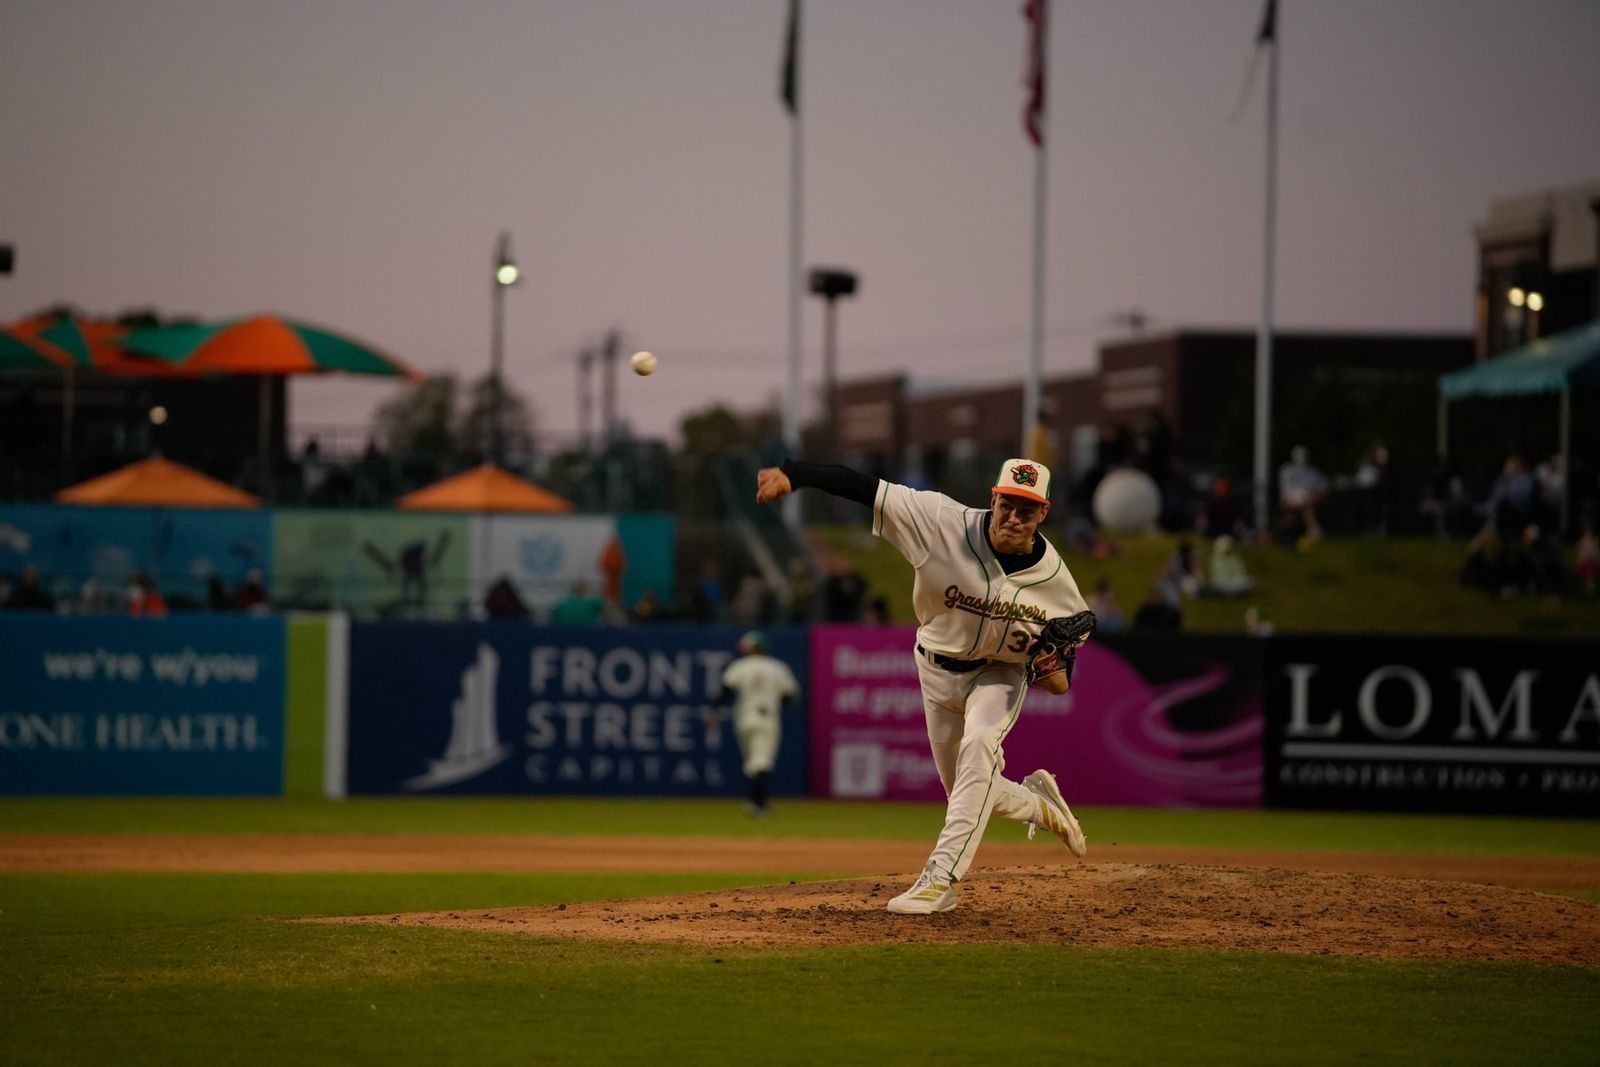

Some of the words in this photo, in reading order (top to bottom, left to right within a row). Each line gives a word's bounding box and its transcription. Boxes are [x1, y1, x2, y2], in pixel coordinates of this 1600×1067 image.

[944, 584, 1046, 624] Grasshoppers
[44, 650, 143, 681] we're
[151, 648, 258, 686] w/you
[529, 646, 732, 698] FRONT
[833, 646, 917, 678] Busin
[1285, 664, 1600, 741] LOMA
[0, 712, 84, 750] ONE
[525, 701, 730, 751] STREET
[525, 754, 724, 786] CAPITAL
[1280, 763, 1505, 789] CONSTRUCTION
